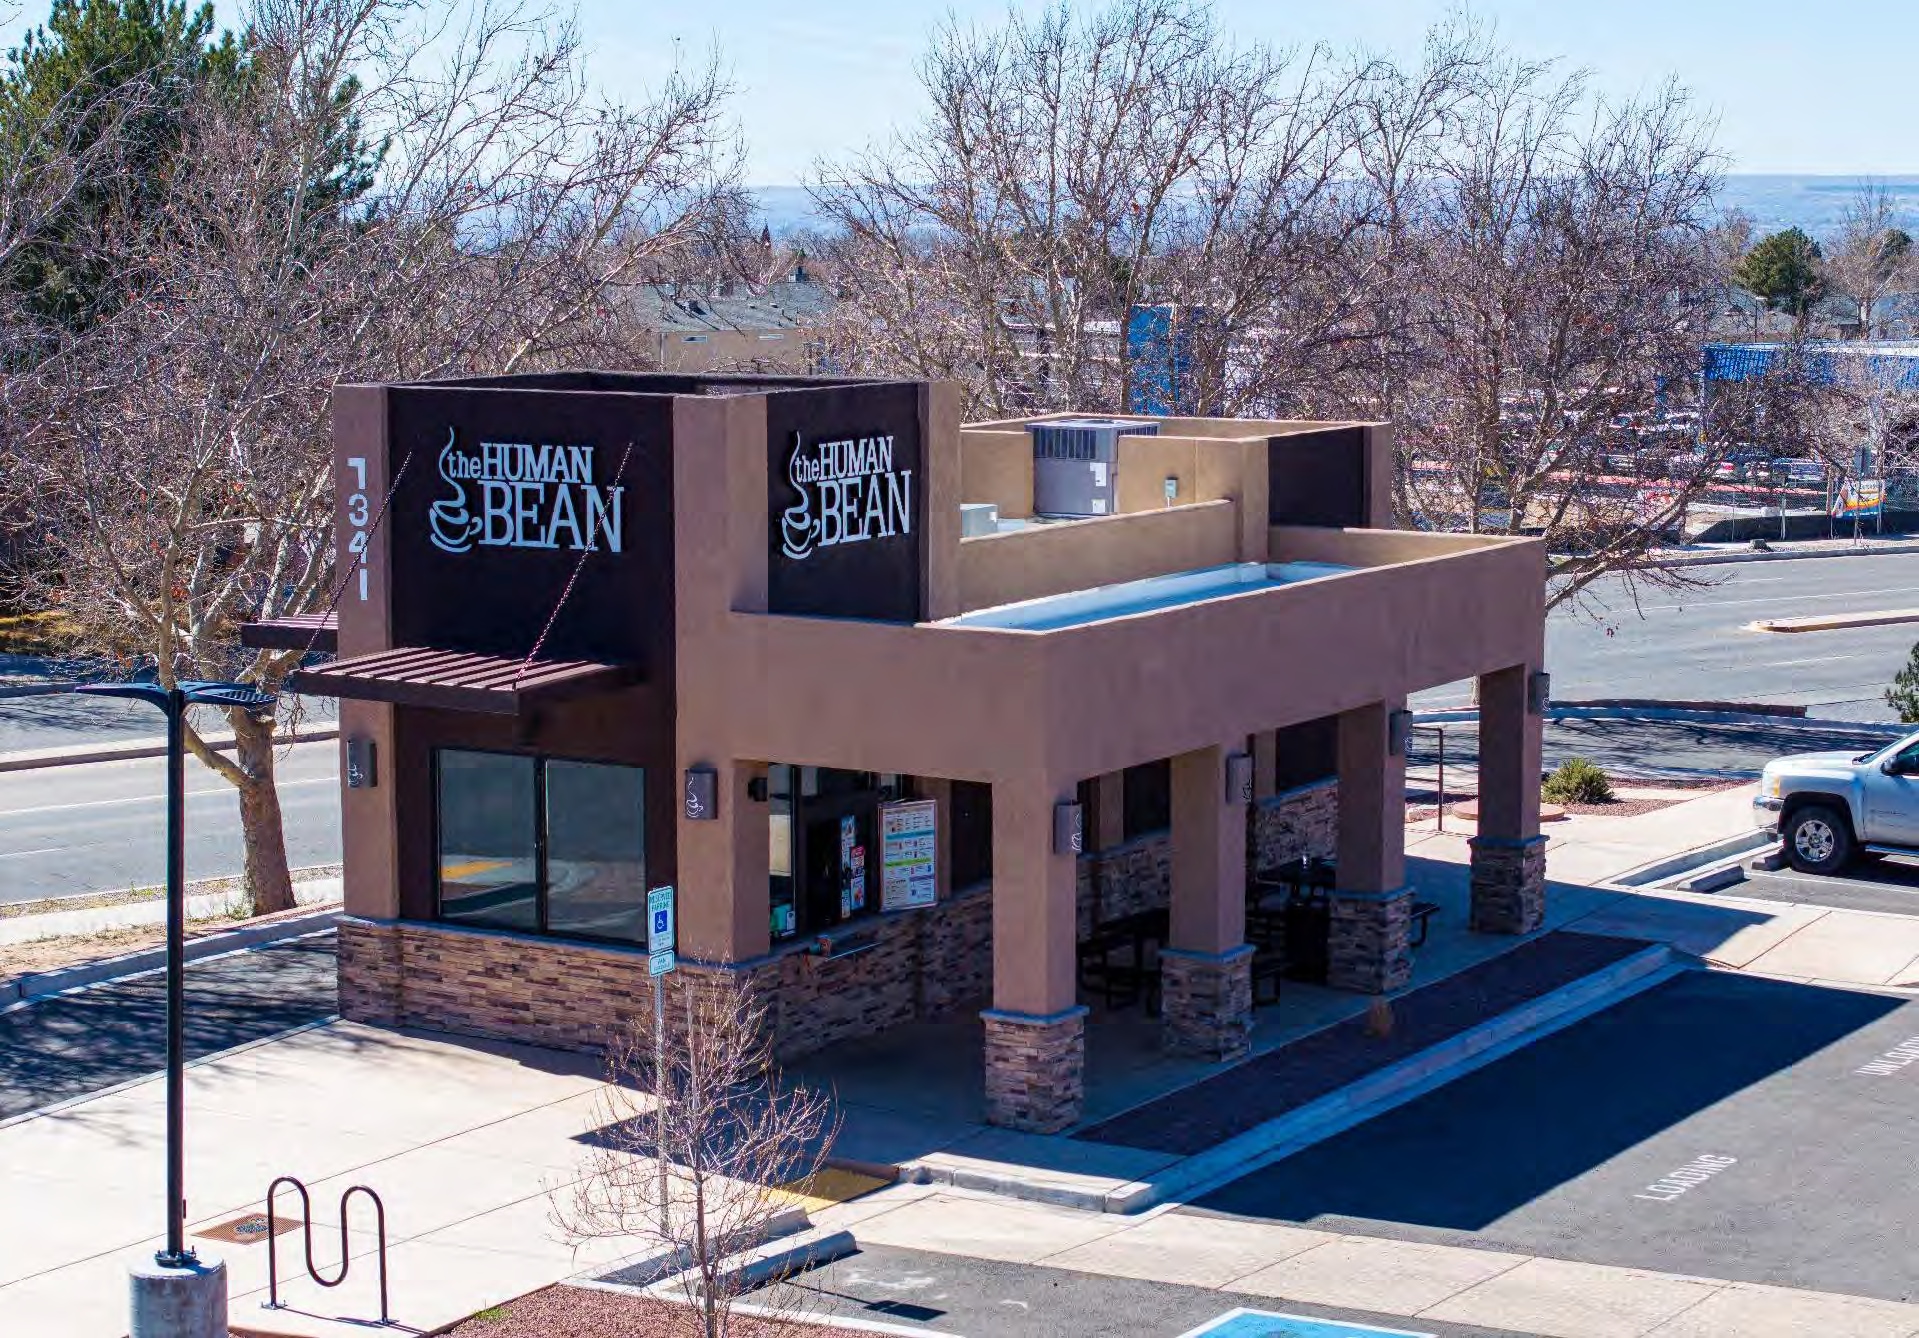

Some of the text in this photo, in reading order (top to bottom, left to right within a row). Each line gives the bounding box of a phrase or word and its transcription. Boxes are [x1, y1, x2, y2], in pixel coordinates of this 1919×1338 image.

[447, 442, 594, 484] the HUMAN
[795, 435, 894, 483] the HUMAN
[477, 480, 625, 553] BEAN
[816, 469, 912, 547] BEAN
[1632, 1154, 1738, 1200] LOADING
